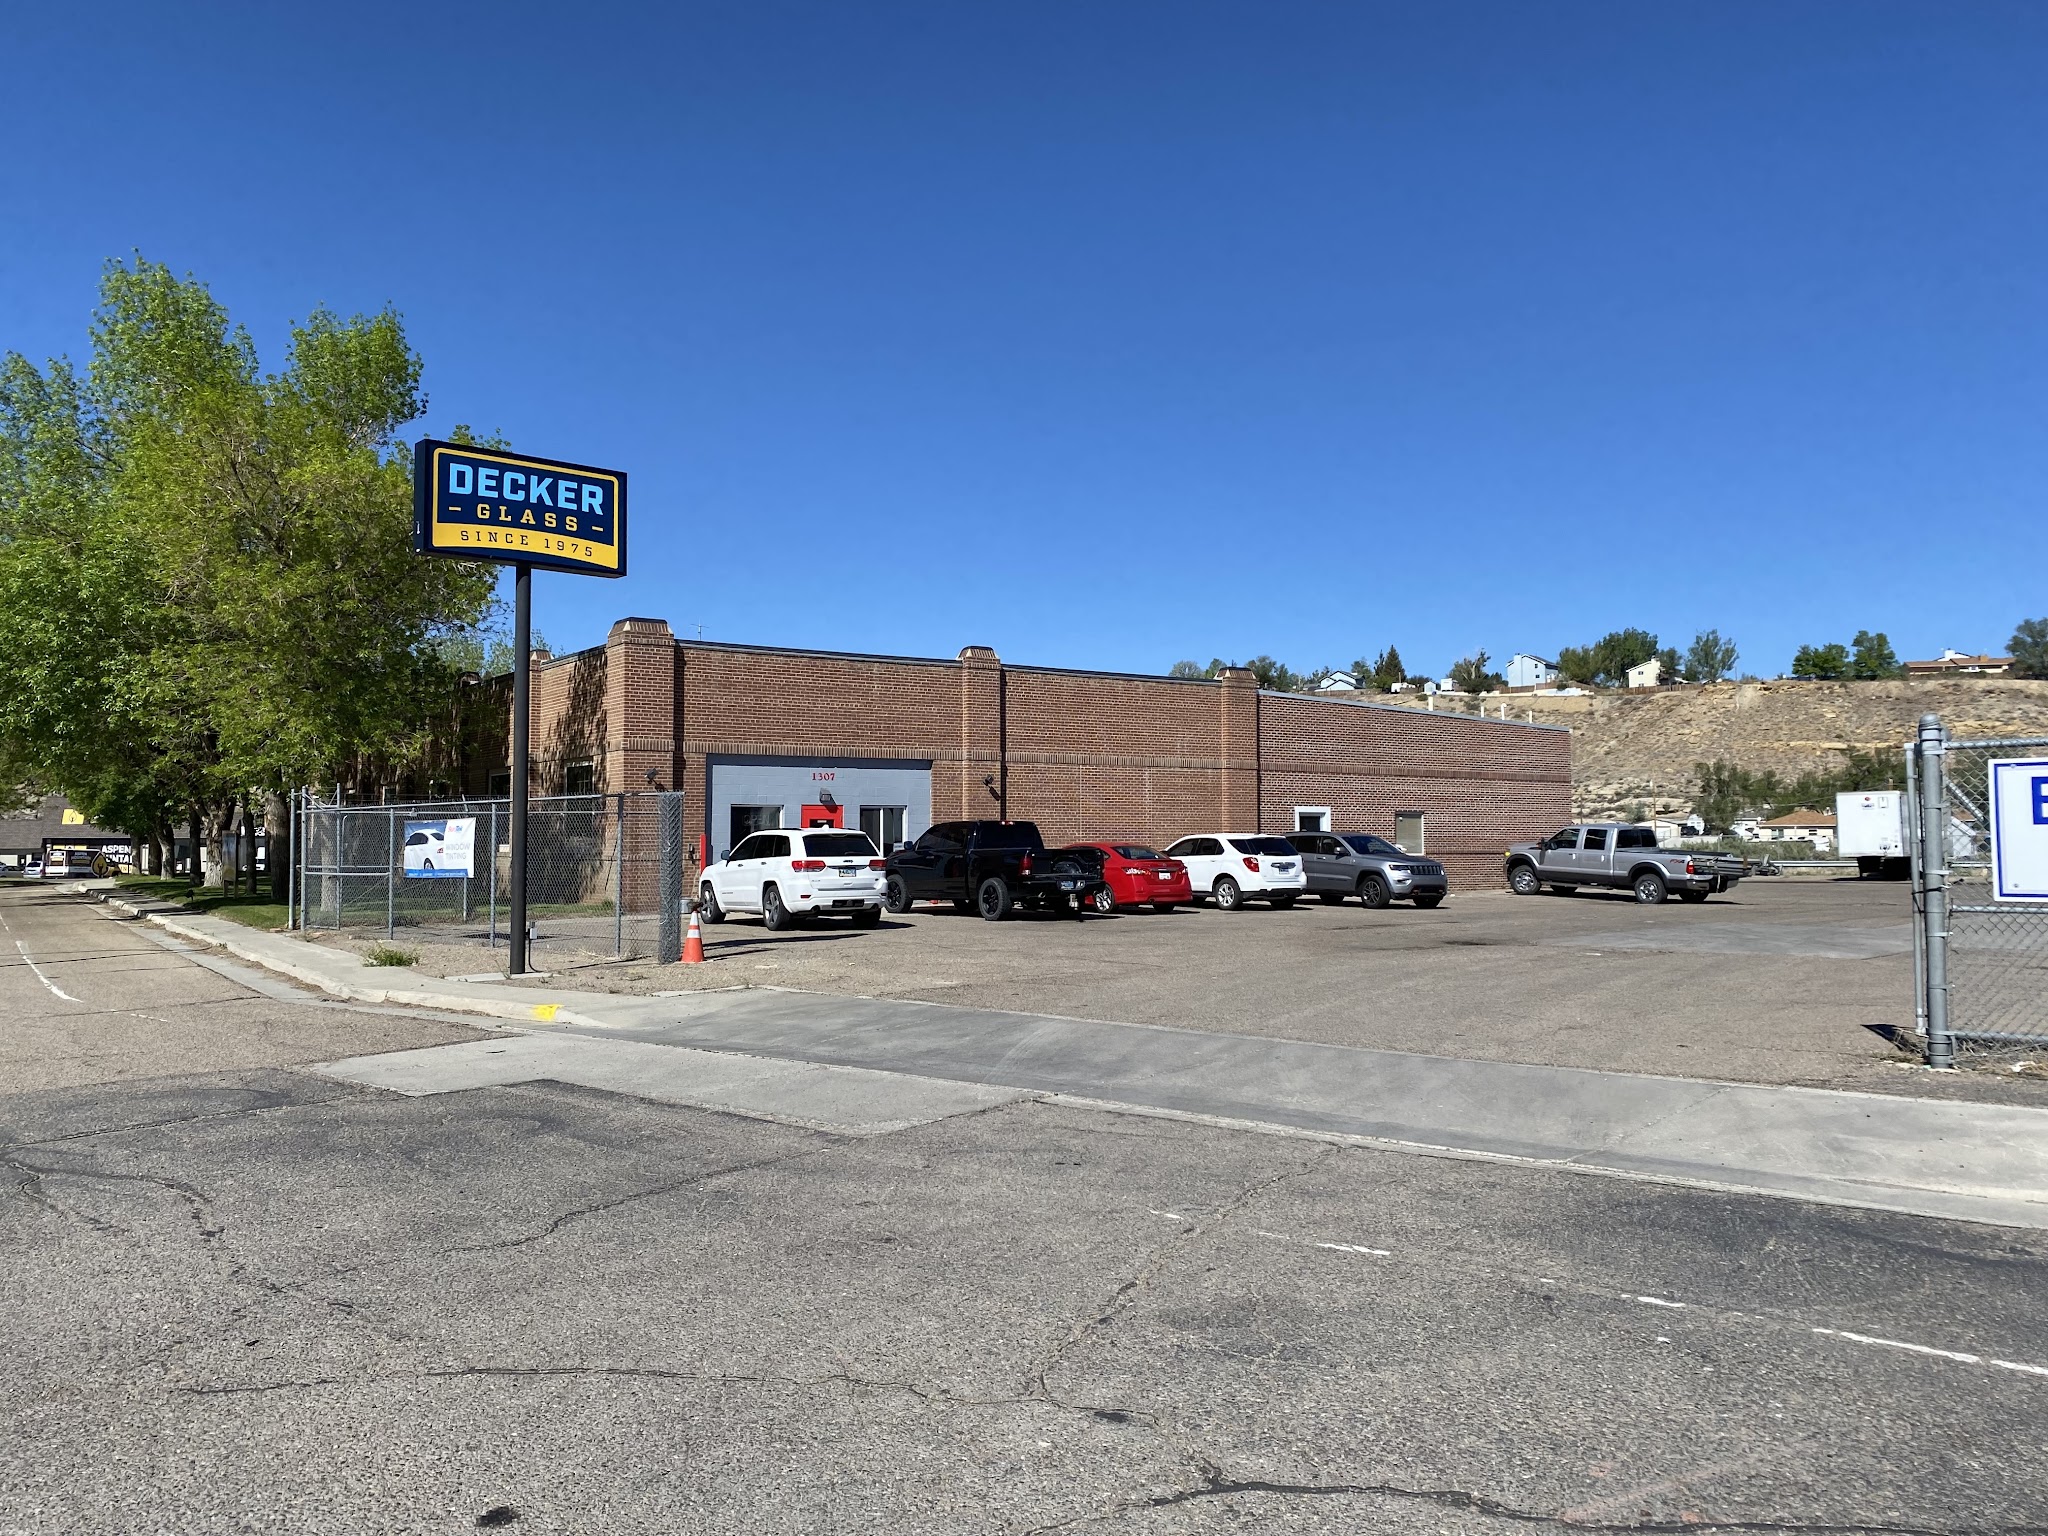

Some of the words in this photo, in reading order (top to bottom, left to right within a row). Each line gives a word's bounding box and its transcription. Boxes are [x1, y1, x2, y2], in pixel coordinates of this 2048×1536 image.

[449, 462, 604, 516] DECKER
[476, 503, 578, 532] GLASS
[461, 530, 529, 546] SINCE
[544, 538, 593, 557] 1975
[812, 772, 836, 781] 1307
[743, 814, 771, 826] OPEN
[102, 845, 131, 853] ASPEN
[445, 843, 470, 851] WINDOW
